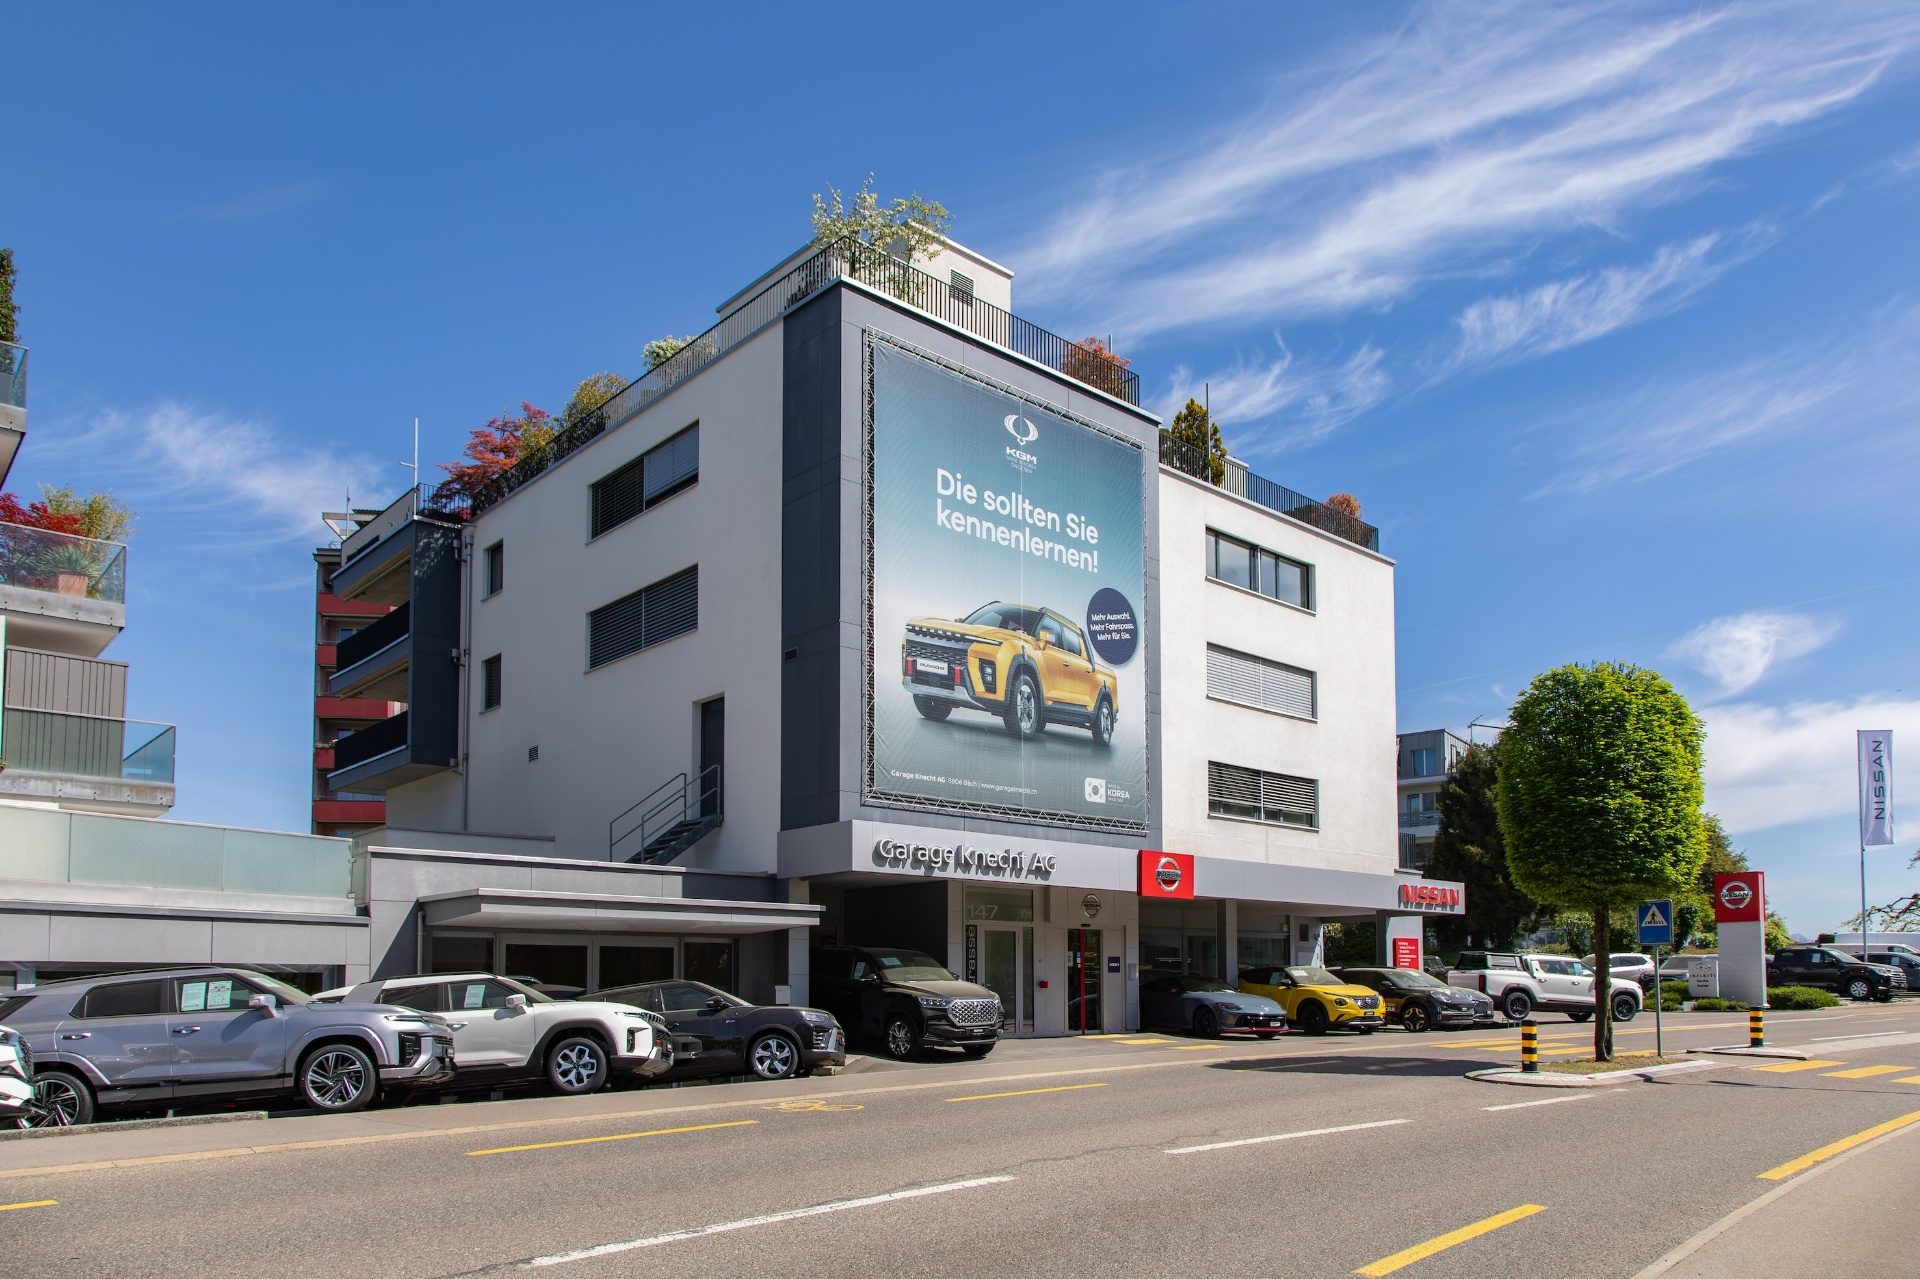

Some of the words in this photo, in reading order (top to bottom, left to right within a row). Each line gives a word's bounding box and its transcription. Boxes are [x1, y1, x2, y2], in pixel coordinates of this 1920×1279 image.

[1006, 446, 1037, 465] KGM
[936, 467, 977, 505] Die
[983, 490, 1060, 533] sollten
[1066, 512, 1099, 544] Sie
[936, 498, 1098, 574] kennenlernen!
[1091, 613, 1106, 621] Mehr
[1107, 612, 1131, 621] Auswahl.
[1090, 623, 1105, 631] Mehr
[1097, 633, 1111, 641] Mehr
[1112, 632, 1120, 640] für
[891, 769, 914, 780] Garage
[915, 773, 937, 782] Knecht
[1871, 740, 1885, 820] NISSAN
[1107, 789, 1130, 799] KOREA
[879, 838, 955, 867] Garage
[960, 845, 1027, 869] Knecht
[1032, 853, 1057, 872] AG
[1403, 884, 1460, 906] NISSAN
[967, 904, 998, 919] 147
